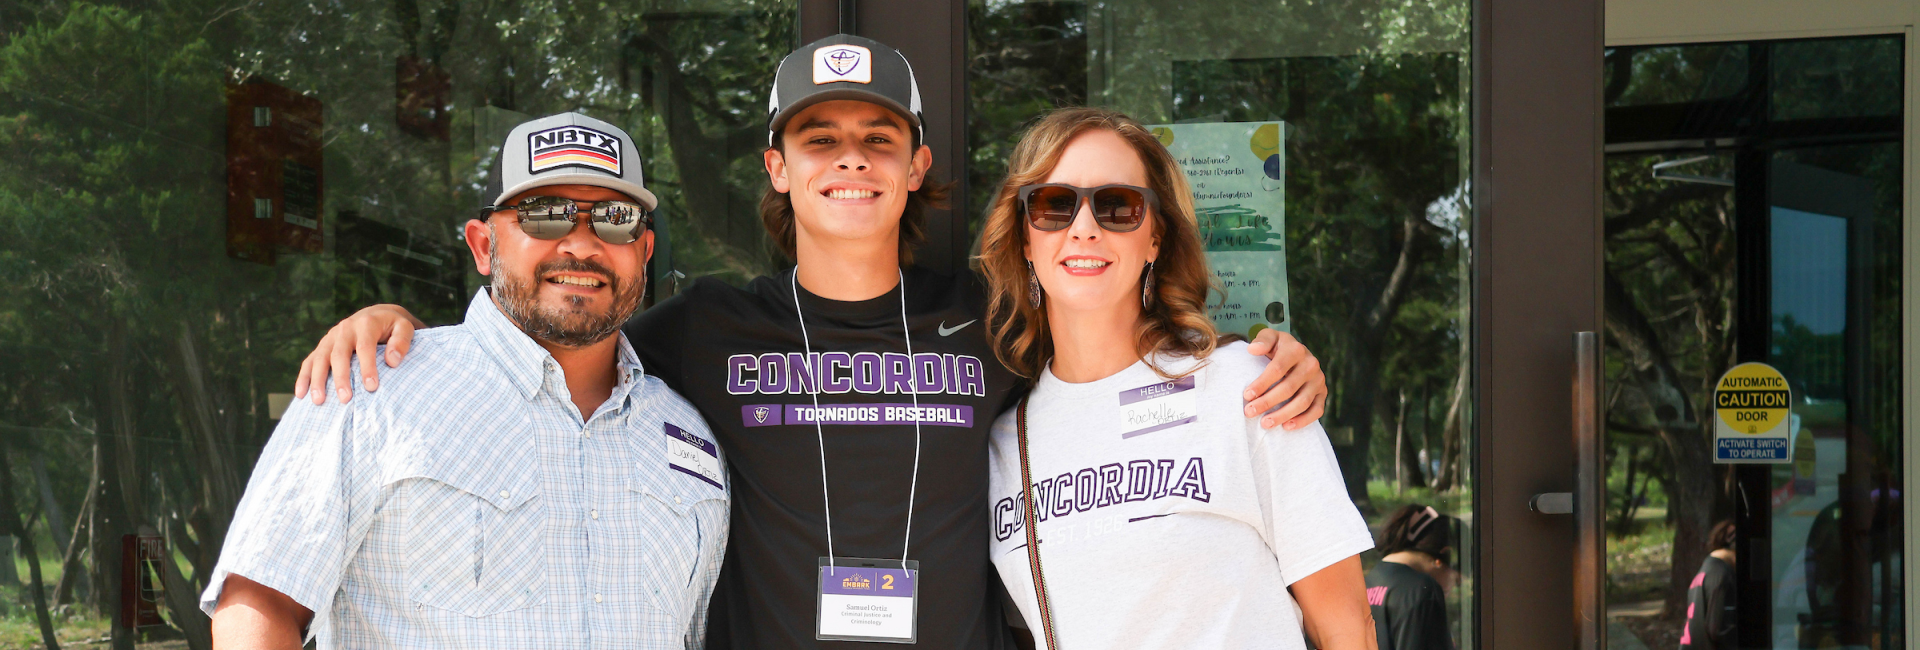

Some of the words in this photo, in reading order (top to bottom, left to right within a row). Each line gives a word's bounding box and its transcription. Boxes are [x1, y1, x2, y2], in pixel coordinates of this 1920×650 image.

[534, 130, 617, 154] NBTX
[1190, 155, 1230, 165] Assistance?
[727, 352, 985, 397] CONCORDIA
[1722, 377, 1782, 388] AUTOMATIC
[1140, 382, 1175, 397] HELLO
[1718, 393, 1786, 406] CAUTION
[795, 407, 879, 422] TORNADOS
[885, 406, 966, 424] BASEBALL
[1127, 402, 1174, 425] Rachelle
[1736, 411, 1768, 422] DOOR
[680, 430, 705, 447] HELLO
[1719, 440, 1755, 448] ACTIVATE
[1756, 440, 1786, 448] SWITCH
[670, 440, 700, 463] Daniel
[1729, 449, 1739, 458] TO
[1740, 449, 1776, 458] OPERATE
[995, 457, 1211, 542] CONCORDIA
[1083, 514, 1124, 540] 1926
[140, 540, 163, 557] FIRE
[881, 574, 894, 590] 2
